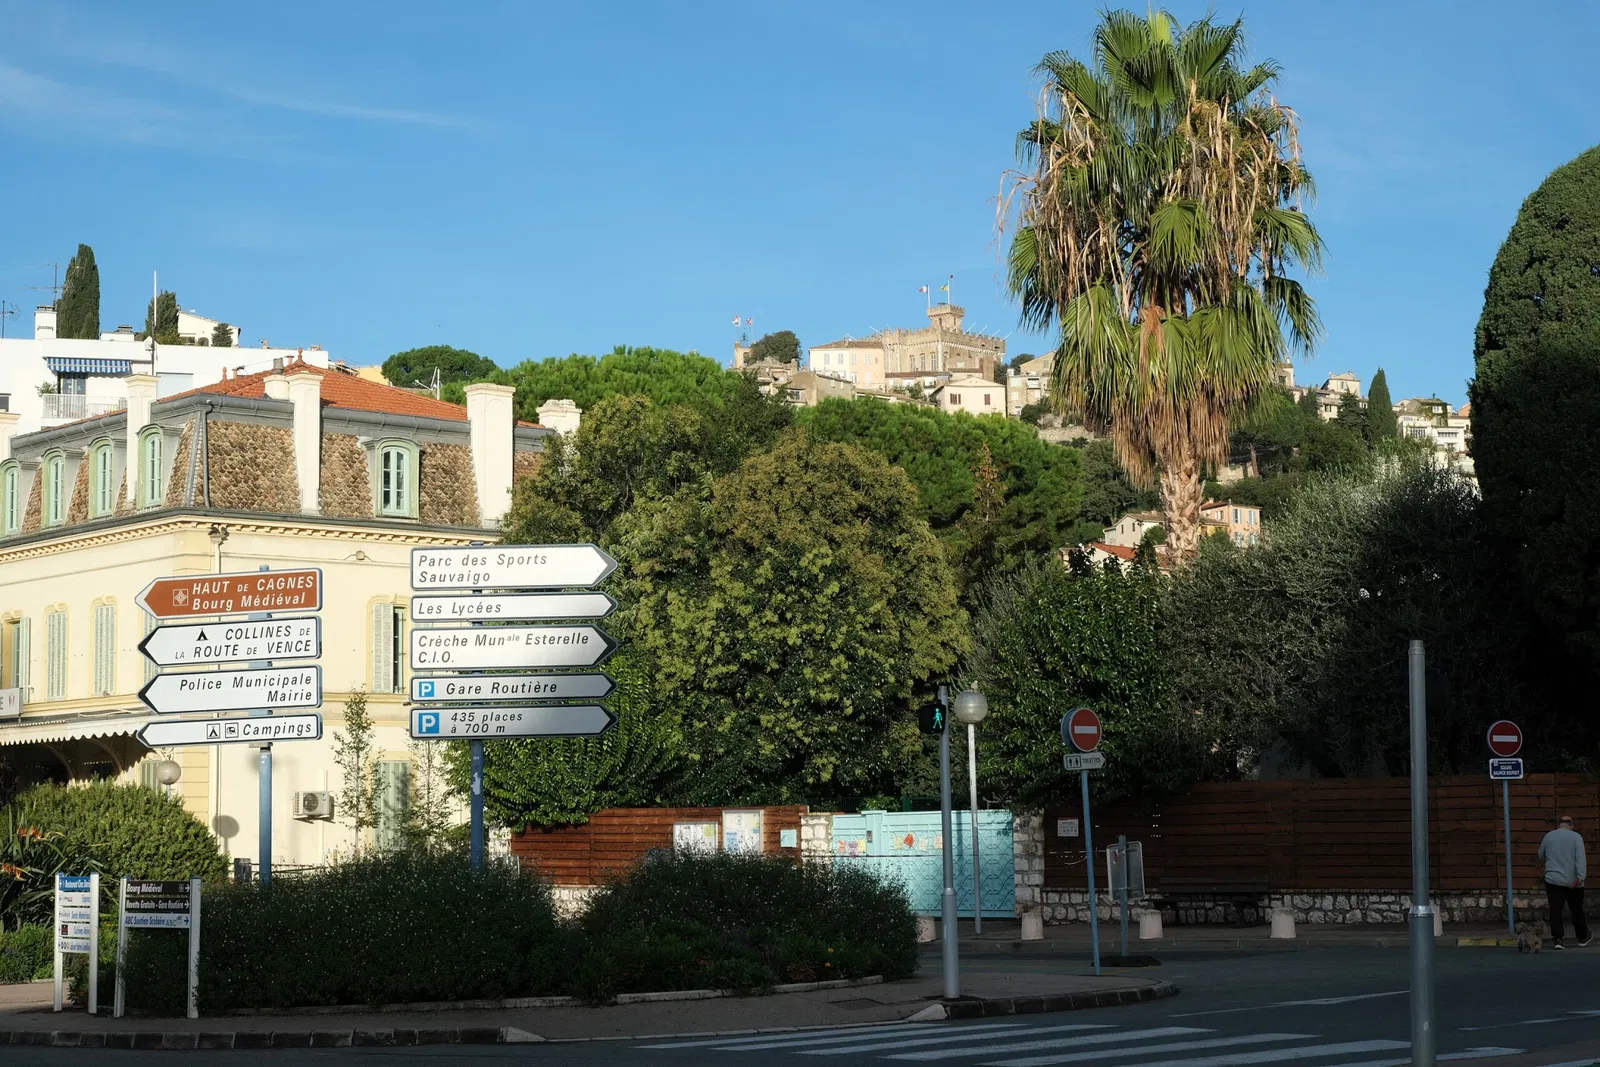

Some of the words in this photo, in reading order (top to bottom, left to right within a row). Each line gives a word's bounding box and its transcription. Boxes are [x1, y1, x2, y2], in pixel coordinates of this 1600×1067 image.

[418, 555, 452, 567] Parc
[462, 554, 487, 567] des
[497, 554, 547, 568] Sports
[419, 570, 490, 585] Sauvaigo
[192, 580, 230, 595] HAUT
[237, 584, 249, 592] DE
[257, 576, 314, 591] CAGNES
[192, 598, 233, 612] Bourg
[240, 592, 305, 608] Médiéval
[418, 602, 443, 615] Les
[452, 601, 502, 616] Lycées
[226, 625, 292, 640] COLLINES
[300, 628, 311, 636] DE
[418, 634, 468, 648] Crèche
[525, 632, 589, 646] Esterelle
[175, 651, 185, 660] LA
[194, 644, 239, 658] ROUTE
[246, 647, 258, 656] DE
[267, 640, 312, 654] VENCE
[418, 651, 455, 664] C.I.O.
[180, 678, 222, 691] Police
[232, 673, 312, 690] Municipale
[446, 682, 482, 696] Gare
[491, 681, 558, 694] Routière
[267, 690, 312, 703] Mairie
[450, 712, 475, 722] 435
[482, 711, 523, 726] places
[242, 722, 312, 739] Campings
[450, 724, 457, 734] à
[465, 723, 489, 734] 700
[126, 883, 140, 894] Bourg
[141, 882, 163, 893] Médiéval
[125, 916, 133, 925] ABC
[134, 916, 148, 925] Soutien
